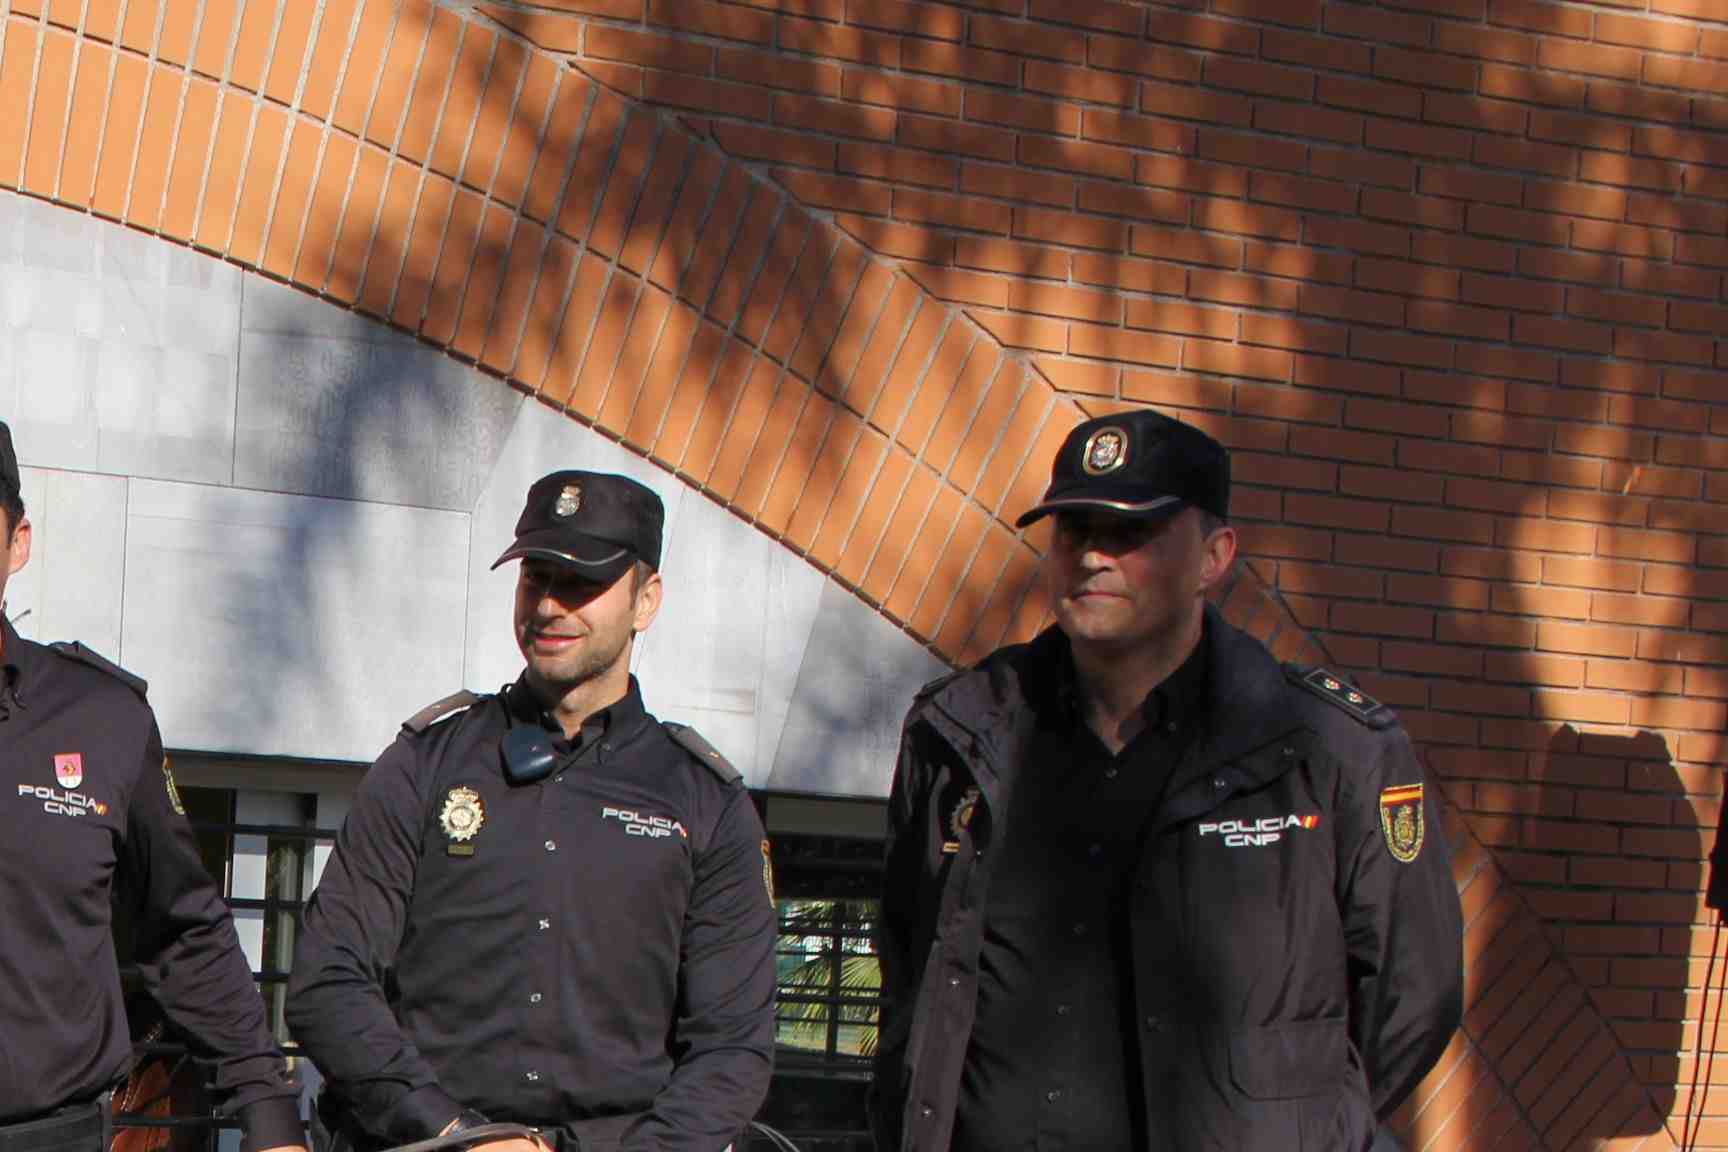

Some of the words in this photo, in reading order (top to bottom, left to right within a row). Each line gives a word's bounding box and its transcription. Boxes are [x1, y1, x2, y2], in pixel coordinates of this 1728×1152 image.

[17, 784, 97, 814] POLICIA
[44, 801, 87, 816] CNP
[602, 807, 684, 836] POLICIA
[625, 823, 671, 838] CNP
[1198, 814, 1301, 836] POLICIA
[1224, 832, 1281, 847] CNP
